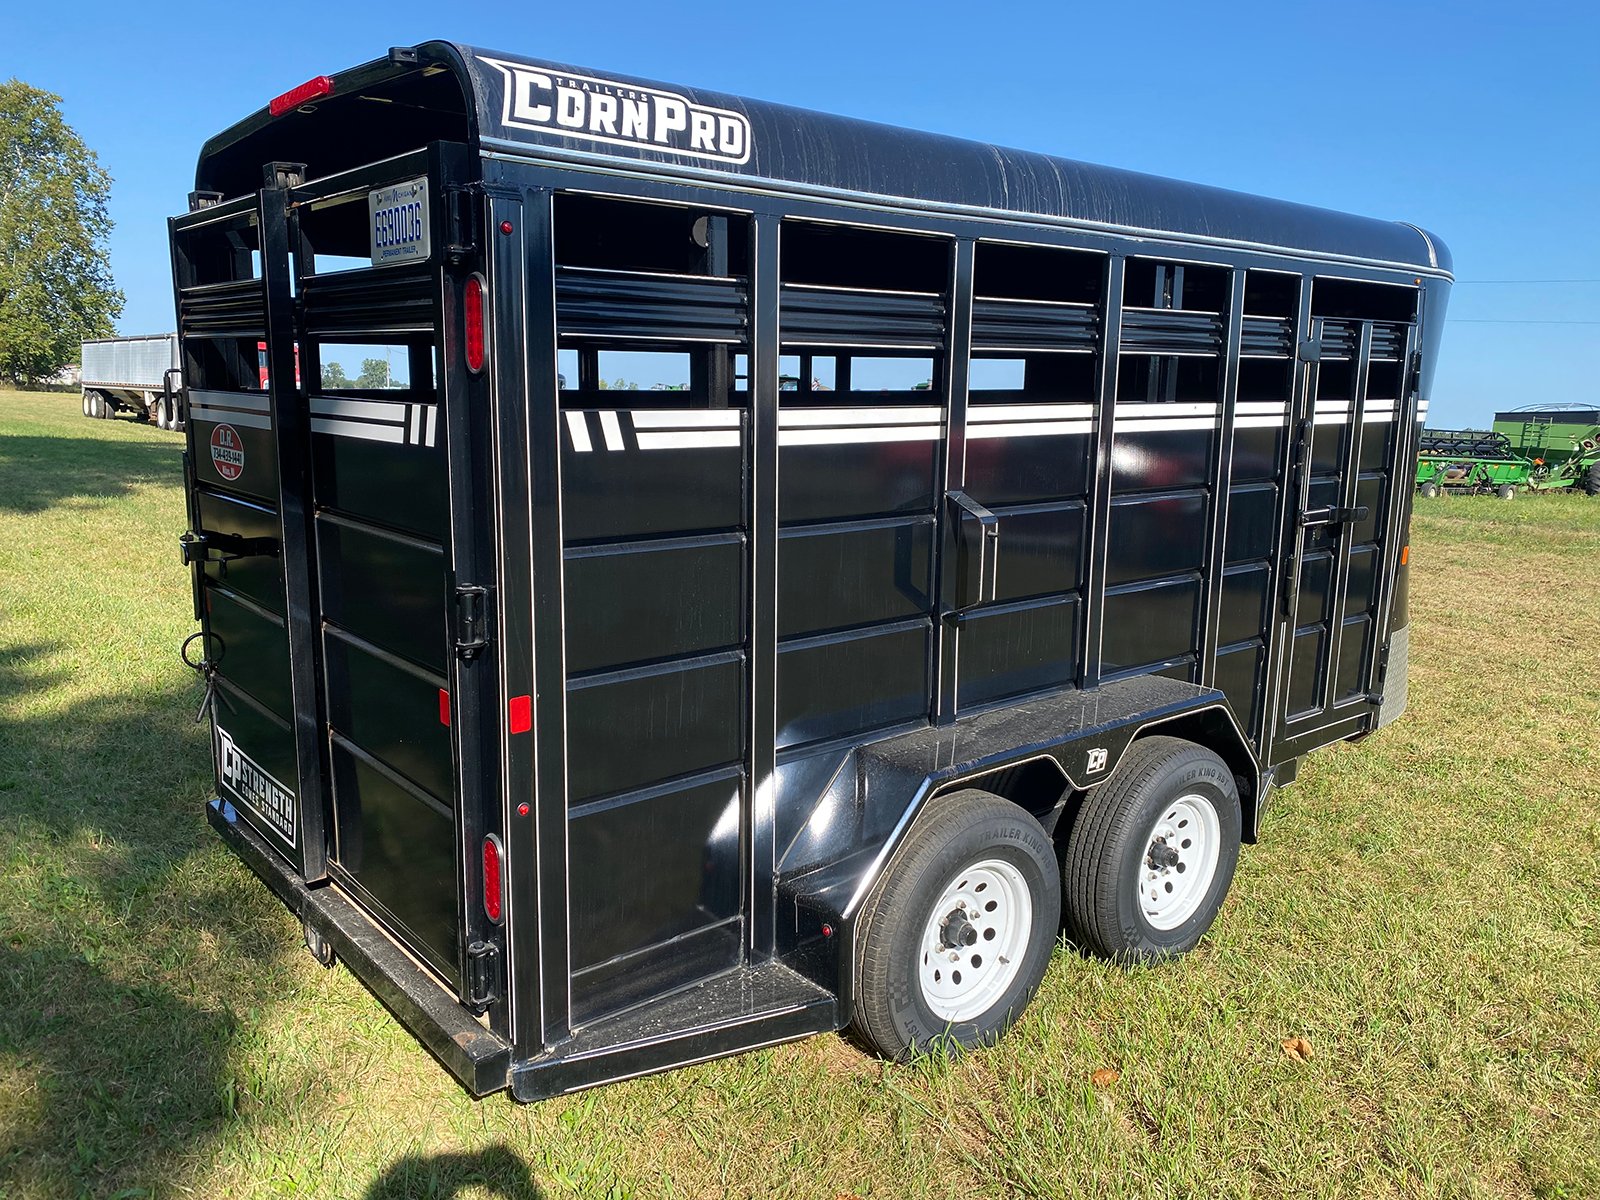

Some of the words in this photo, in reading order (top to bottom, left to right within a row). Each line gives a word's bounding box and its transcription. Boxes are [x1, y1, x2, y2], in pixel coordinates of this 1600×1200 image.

[555, 77, 648, 102] TRAILERS
[375, 201, 422, 248] E690036
[222, 736, 241, 788] CP
[241, 760, 293, 822] STRENGTH
[1198, 767, 1216, 778] KING
[261, 800, 293, 836] STANDARD
[979, 827, 1021, 843] TRAILER
[1021, 831, 1043, 855] KING
